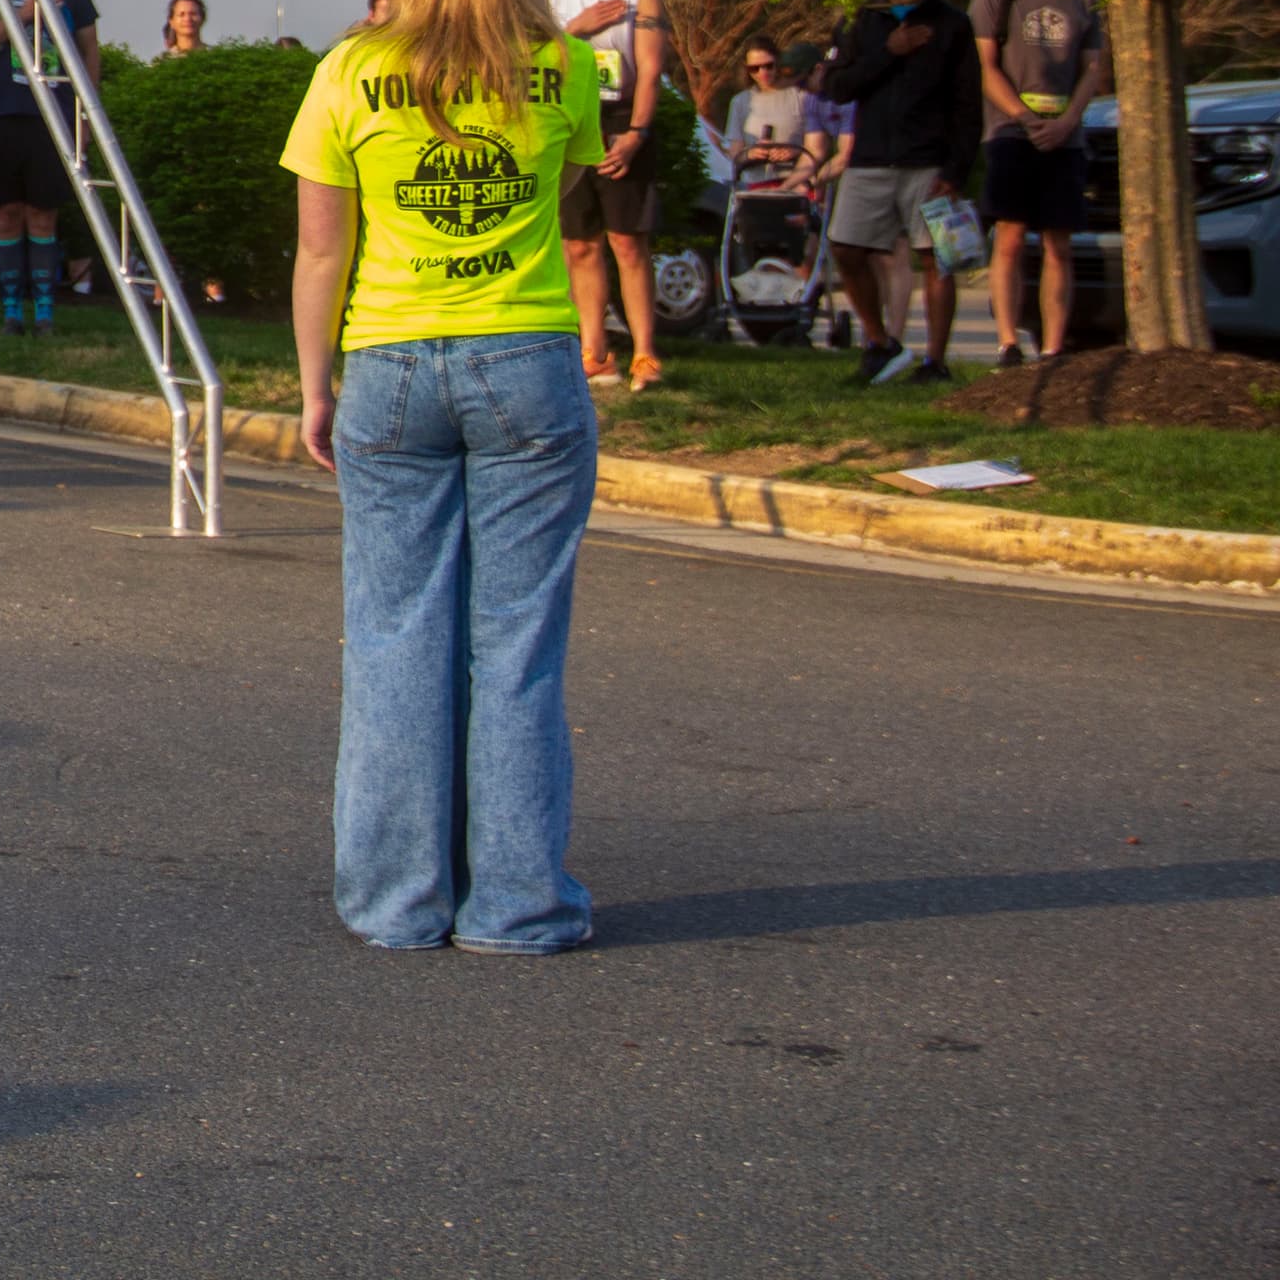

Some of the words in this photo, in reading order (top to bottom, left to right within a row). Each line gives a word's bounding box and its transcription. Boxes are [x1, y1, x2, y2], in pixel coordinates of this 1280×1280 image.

[361, 66, 562, 113] VOLNER
[463, 124, 485, 135] FREE
[486, 129, 516, 152] COFFEE
[397, 178, 534, 207] SHEETZ-TO-SHEETZ
[432, 215, 471, 237] TRAIL
[474, 212, 503, 235] RUN
[409, 254, 453, 273] Visit
[445, 249, 517, 280] KGVA
